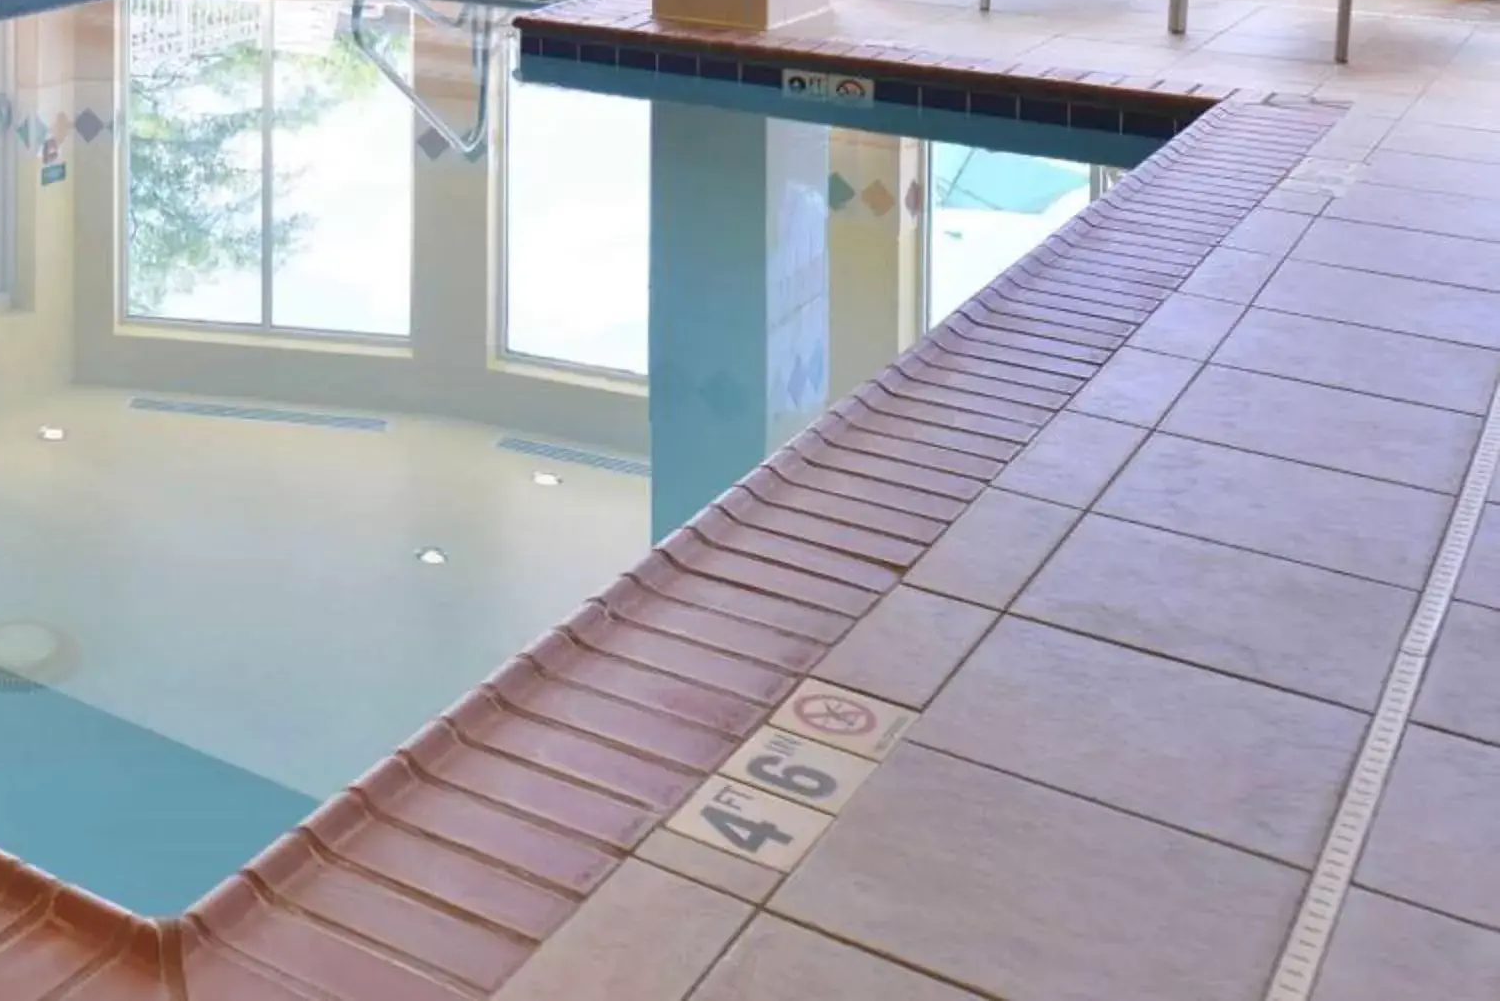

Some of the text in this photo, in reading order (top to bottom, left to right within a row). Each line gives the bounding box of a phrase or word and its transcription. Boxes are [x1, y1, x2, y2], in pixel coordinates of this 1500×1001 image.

[700, 733, 838, 854] 4 FT 6 IN
